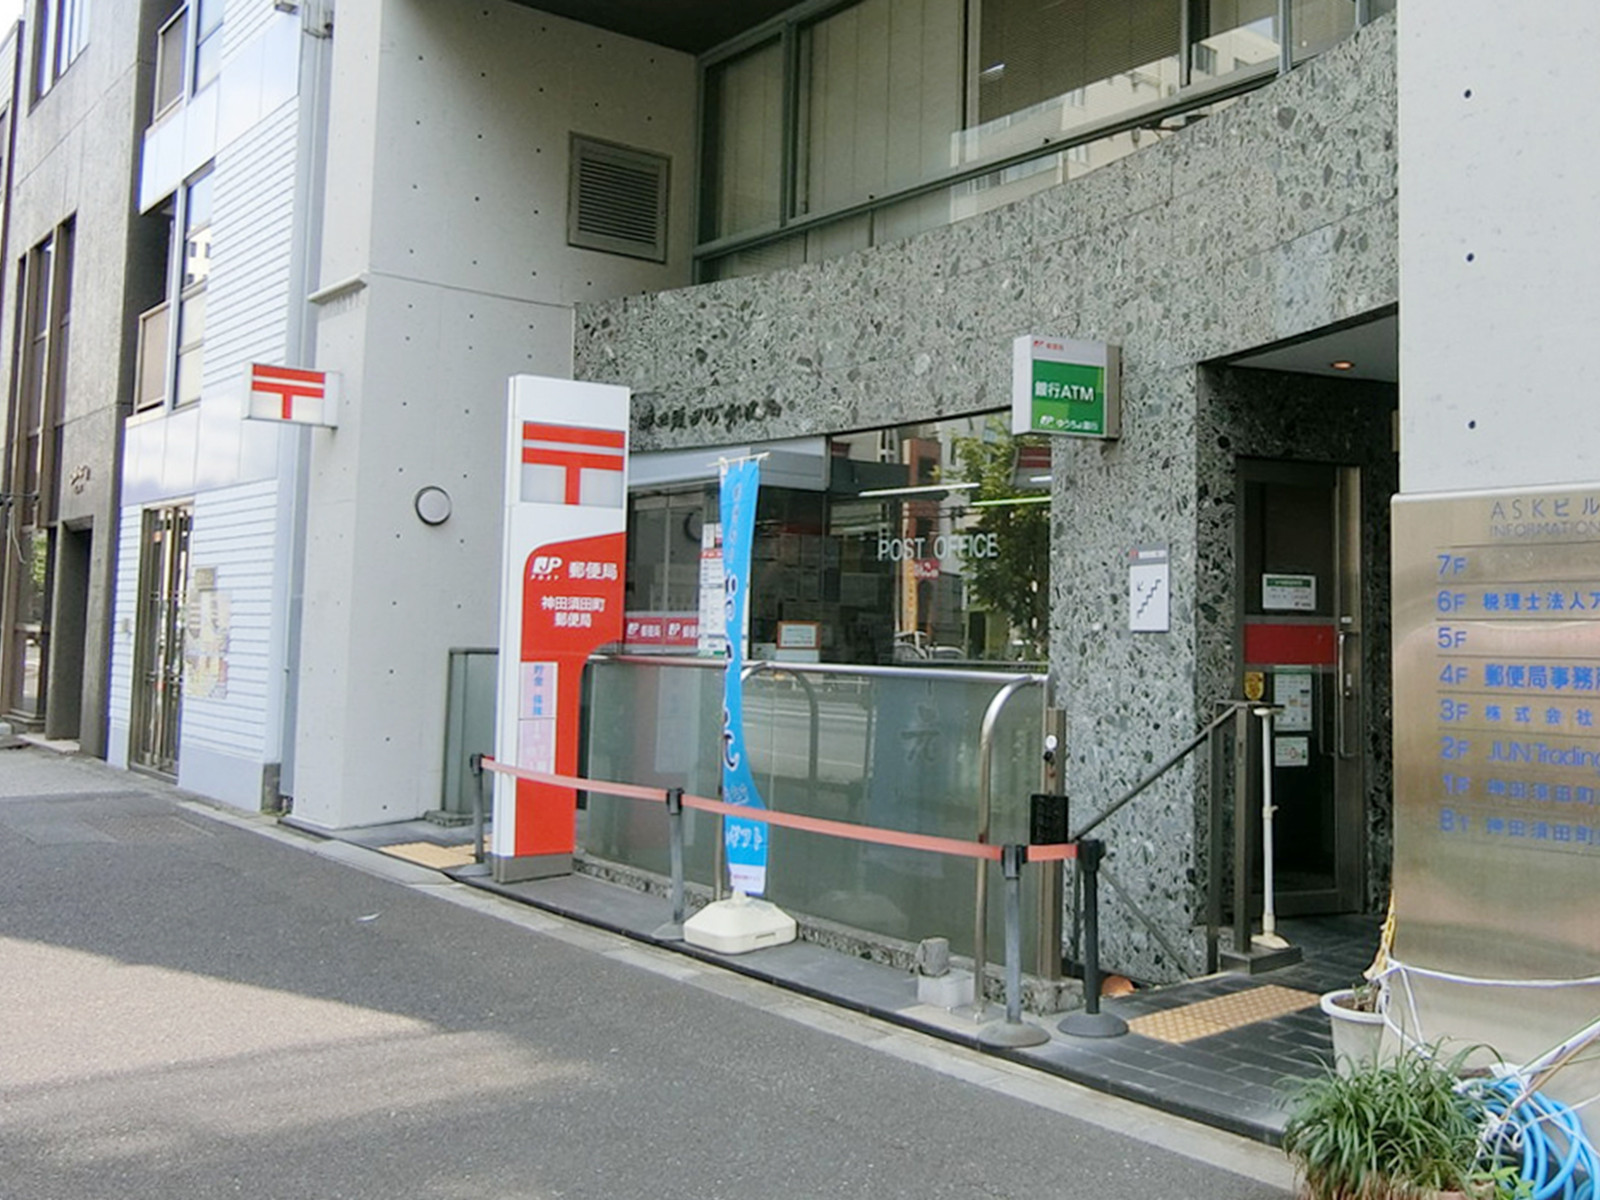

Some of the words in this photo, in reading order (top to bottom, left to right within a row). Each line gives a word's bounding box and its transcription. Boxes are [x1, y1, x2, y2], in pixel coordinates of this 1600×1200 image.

[1034, 381, 1095, 402] 銀行ATM
[878, 537, 926, 561] POST
[933, 532, 999, 558] OFFICE
[568, 561, 618, 581] 郵便局
[1437, 554, 1467, 575] 7F
[541, 596, 605, 612] 神田須田町
[1437, 590, 1467, 612] 6F
[554, 612, 592, 628] 郵便局
[1437, 627, 1468, 648] 5F
[1439, 664, 1468, 686] 4F
[1484, 664, 1600, 690] 郵便局事務
[1440, 699, 1470, 721] 3F
[1440, 736, 1470, 760] 2F
